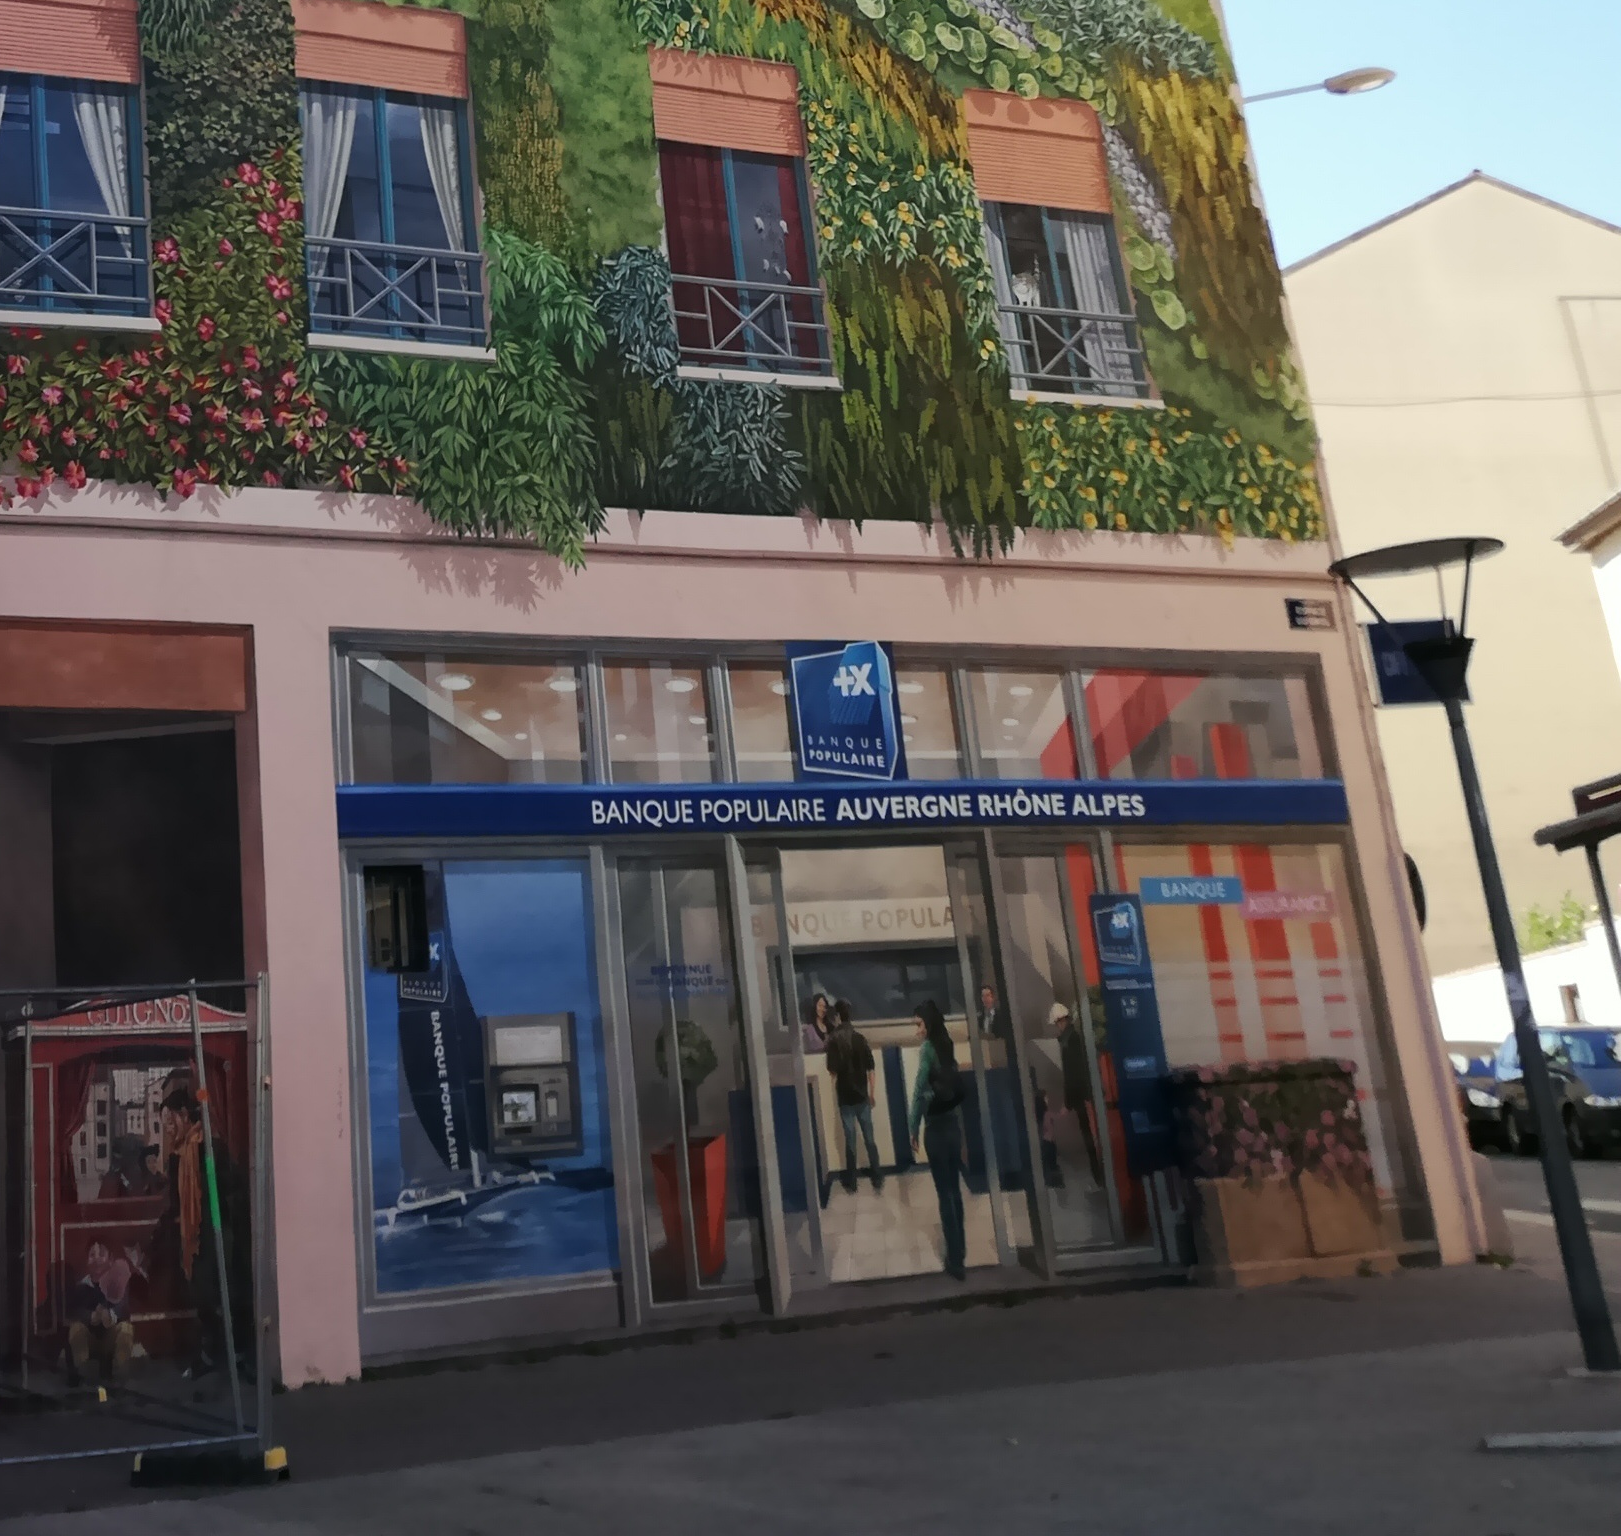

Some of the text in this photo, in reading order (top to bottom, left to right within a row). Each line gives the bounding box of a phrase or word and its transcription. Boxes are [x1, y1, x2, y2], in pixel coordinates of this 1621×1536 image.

[807, 735, 883, 750] BANQUE
[809, 749, 886, 768] POPULAIRE
[591, 788, 1146, 828] BANQUE POPULAIRE AUVERGNE RHÔNE ALPES
[1160, 881, 1227, 899] BANQUE
[431, 1009, 448, 1078] BANQUE
